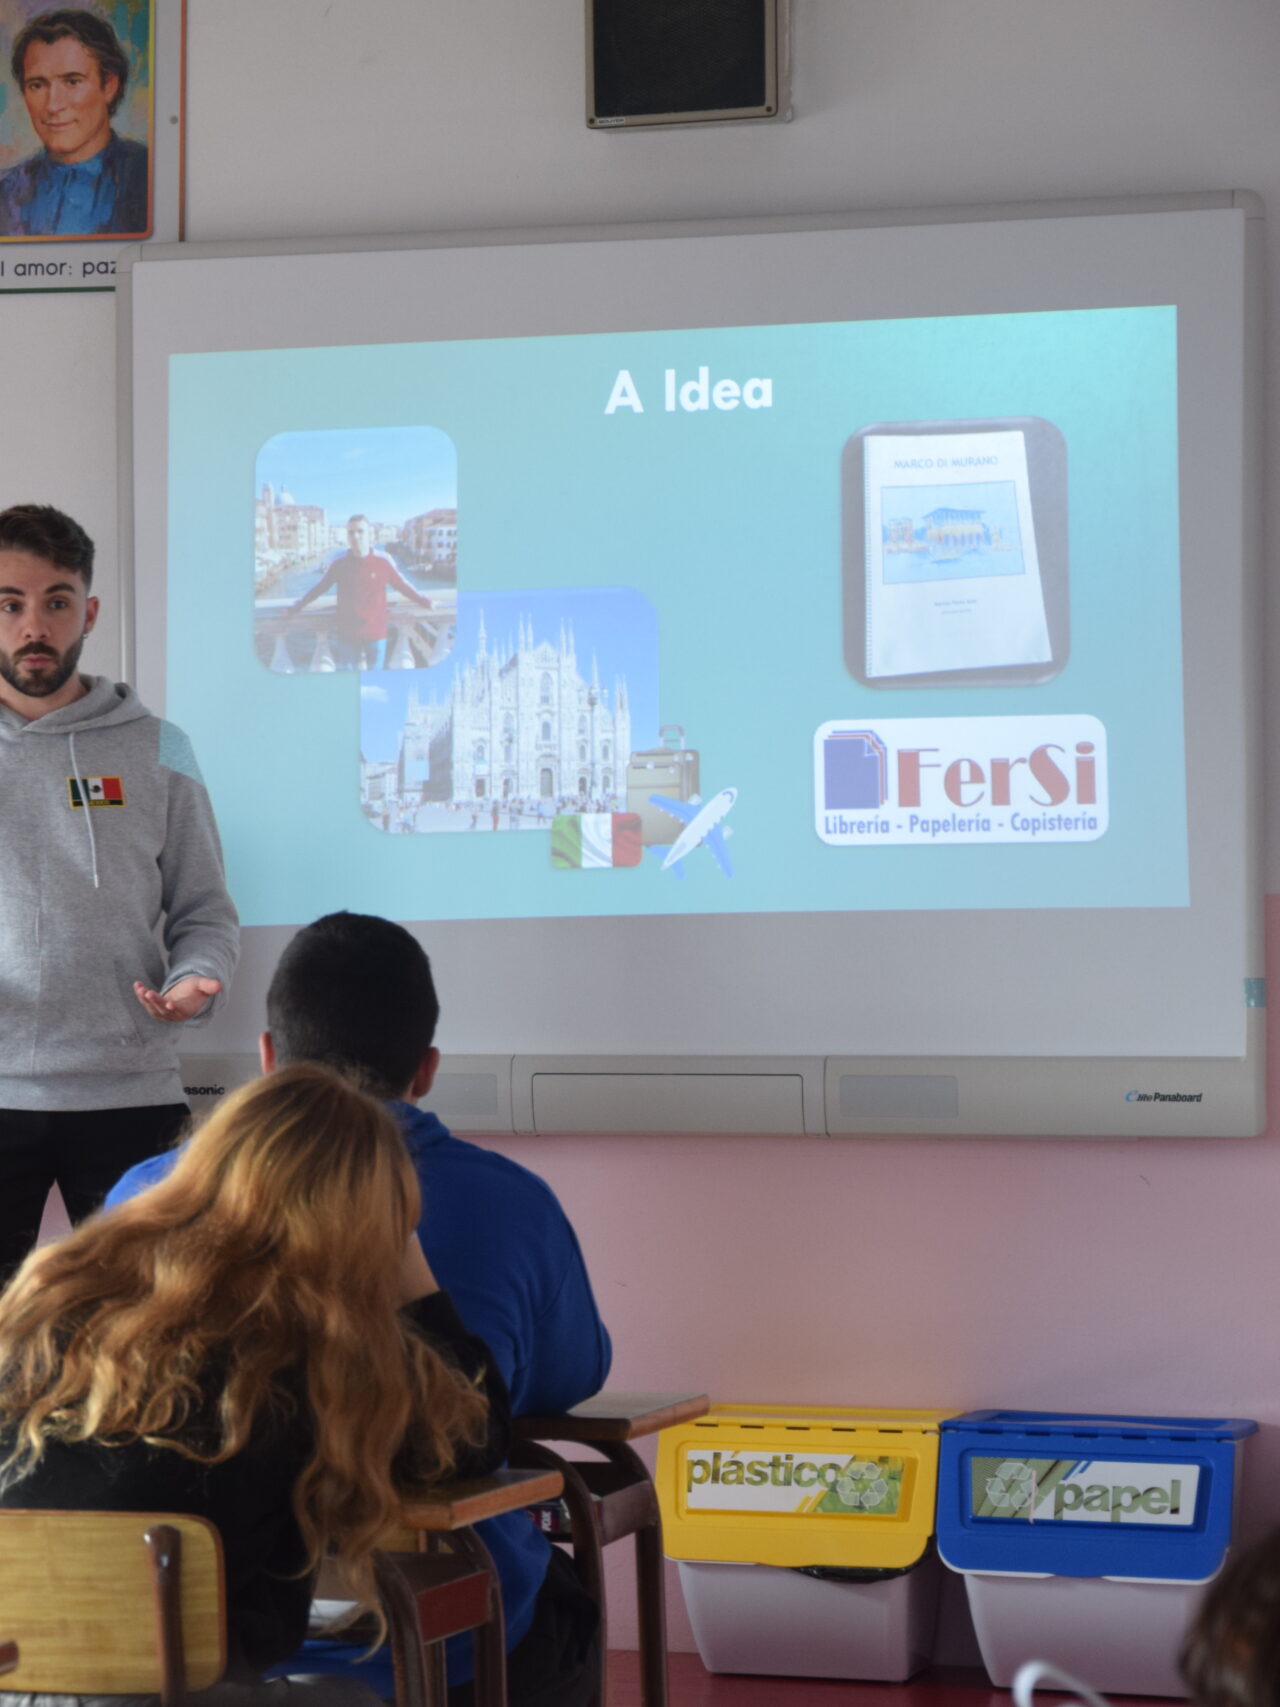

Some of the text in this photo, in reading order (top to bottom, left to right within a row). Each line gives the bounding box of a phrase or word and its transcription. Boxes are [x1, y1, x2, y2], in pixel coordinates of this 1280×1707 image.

[14, 263, 72, 276] amor:
[604, 366, 772, 414] A Idea
[897, 741, 1097, 807] FerSi
[825, 815, 890, 835] Librería
[909, 812, 991, 837] Papelería
[1010, 811, 1098, 836] Copistería
[183, 1084, 225, 1095] asonic
[1153, 1091, 1203, 1102] Panaboard
[688, 1450, 844, 1493] plástico
[1054, 1479, 1181, 1523] papel
